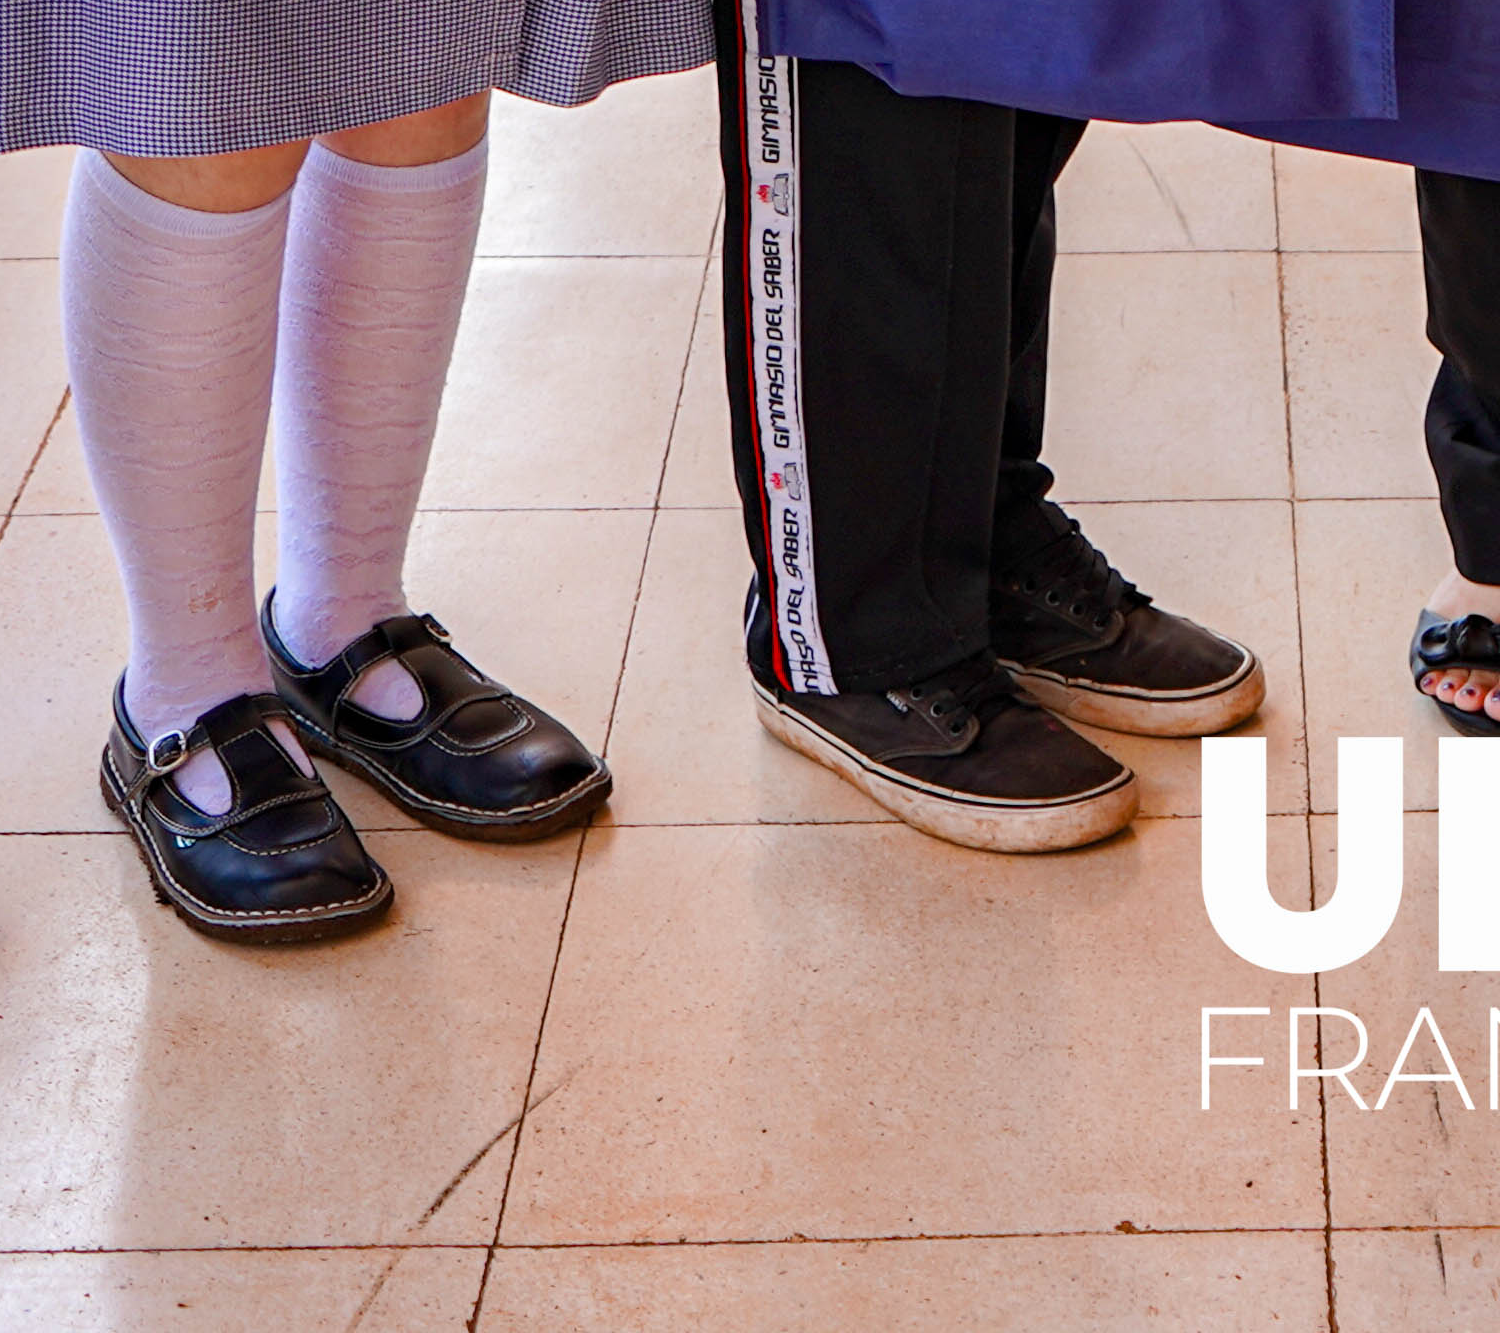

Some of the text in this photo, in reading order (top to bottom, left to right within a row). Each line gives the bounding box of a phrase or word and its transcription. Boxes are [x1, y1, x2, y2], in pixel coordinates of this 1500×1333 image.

[758, 55, 781, 165] GIMNASIO
[763, 228, 790, 449] GIMNASIO DEL SABER
[782, 507, 804, 581] SABER
[787, 585, 805, 626] DEL
